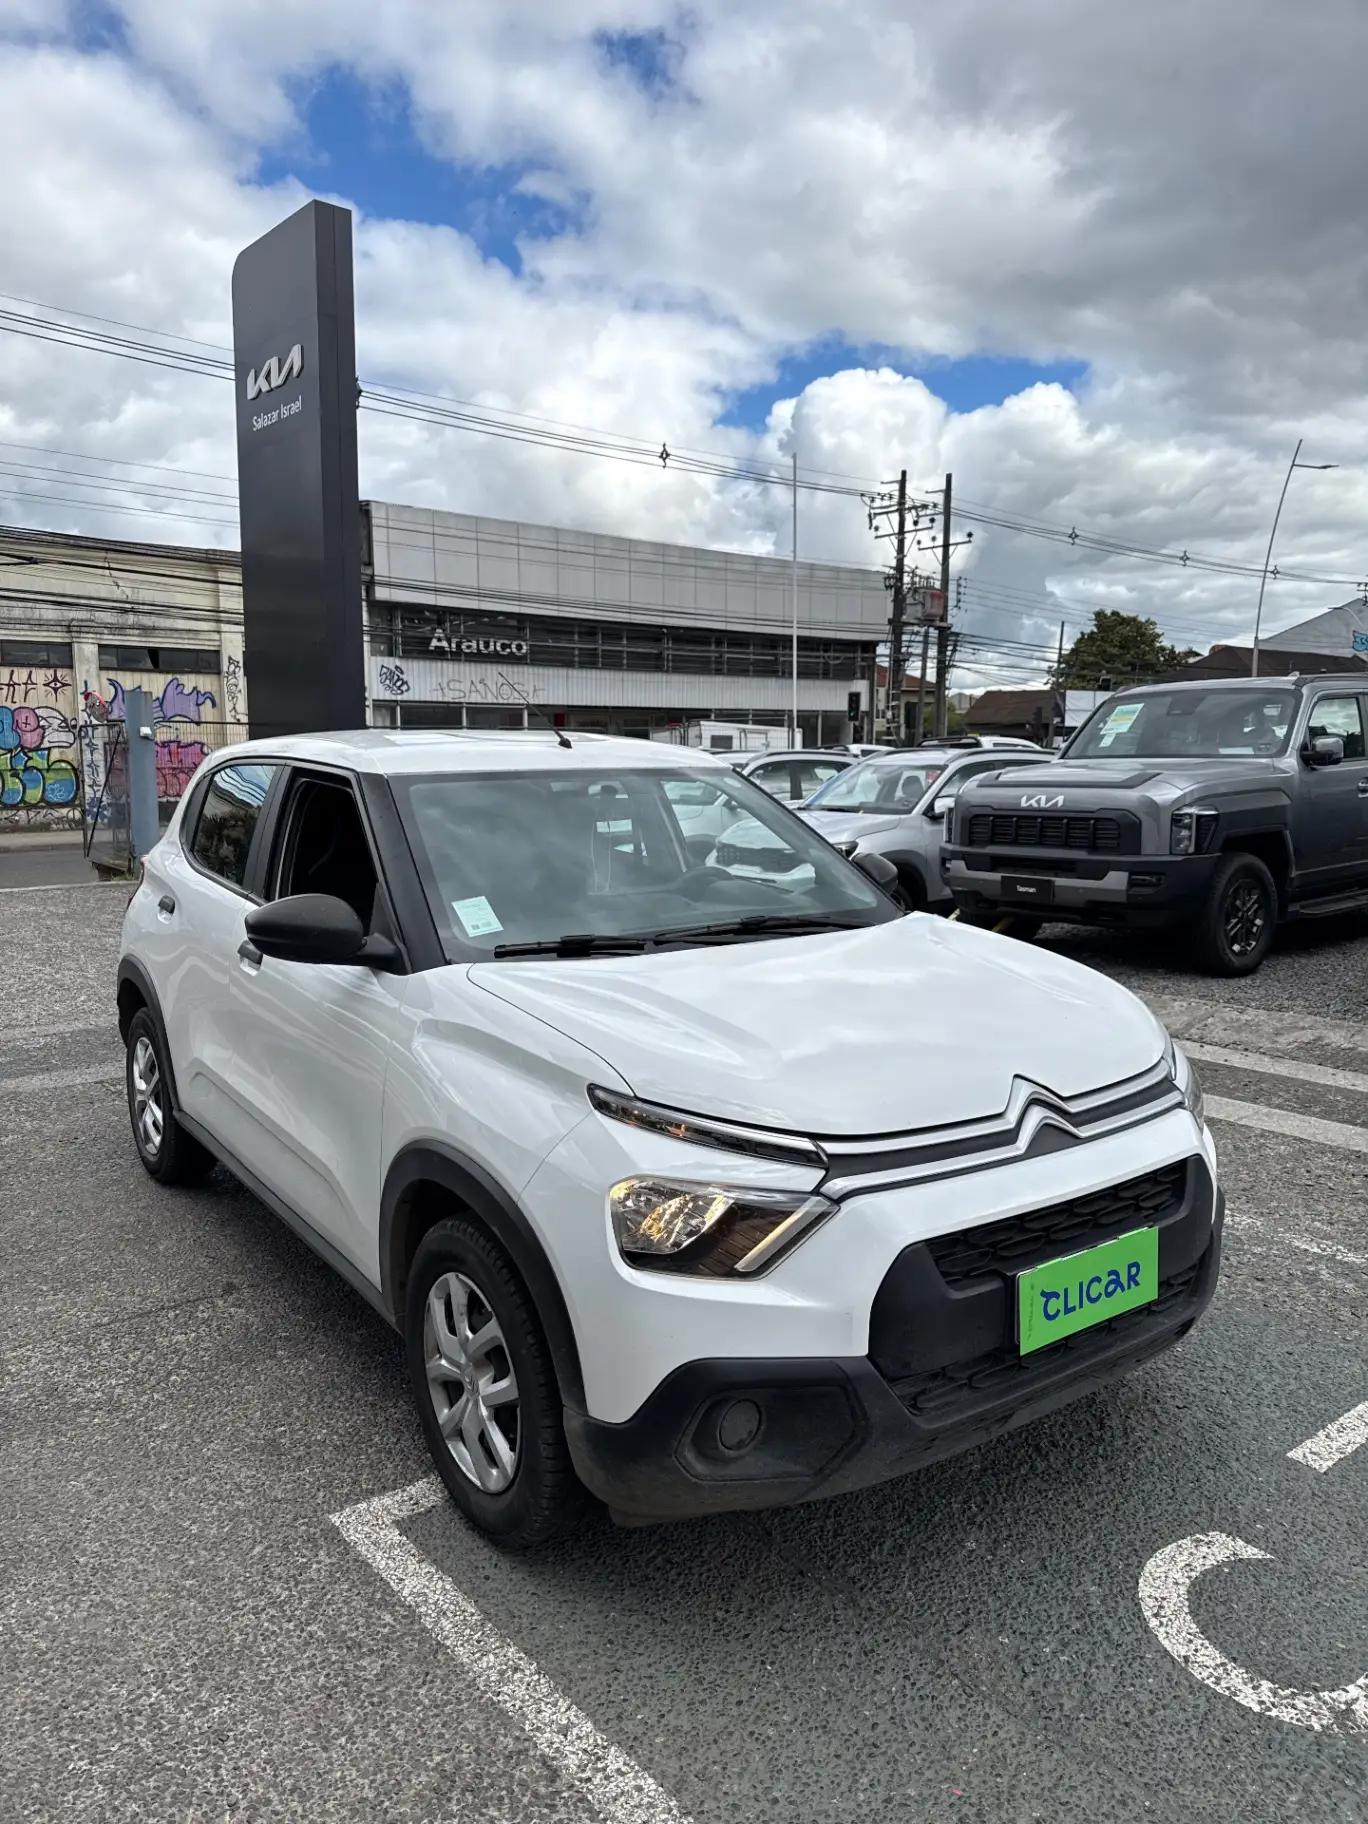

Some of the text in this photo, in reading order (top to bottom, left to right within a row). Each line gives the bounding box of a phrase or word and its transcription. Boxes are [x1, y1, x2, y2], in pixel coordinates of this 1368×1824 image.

[246, 343, 302, 401] KIA
[252, 394, 302, 432] Salazar Israel
[428, 628, 528, 656] Arauco
[1020, 794, 1065, 808] KIA
